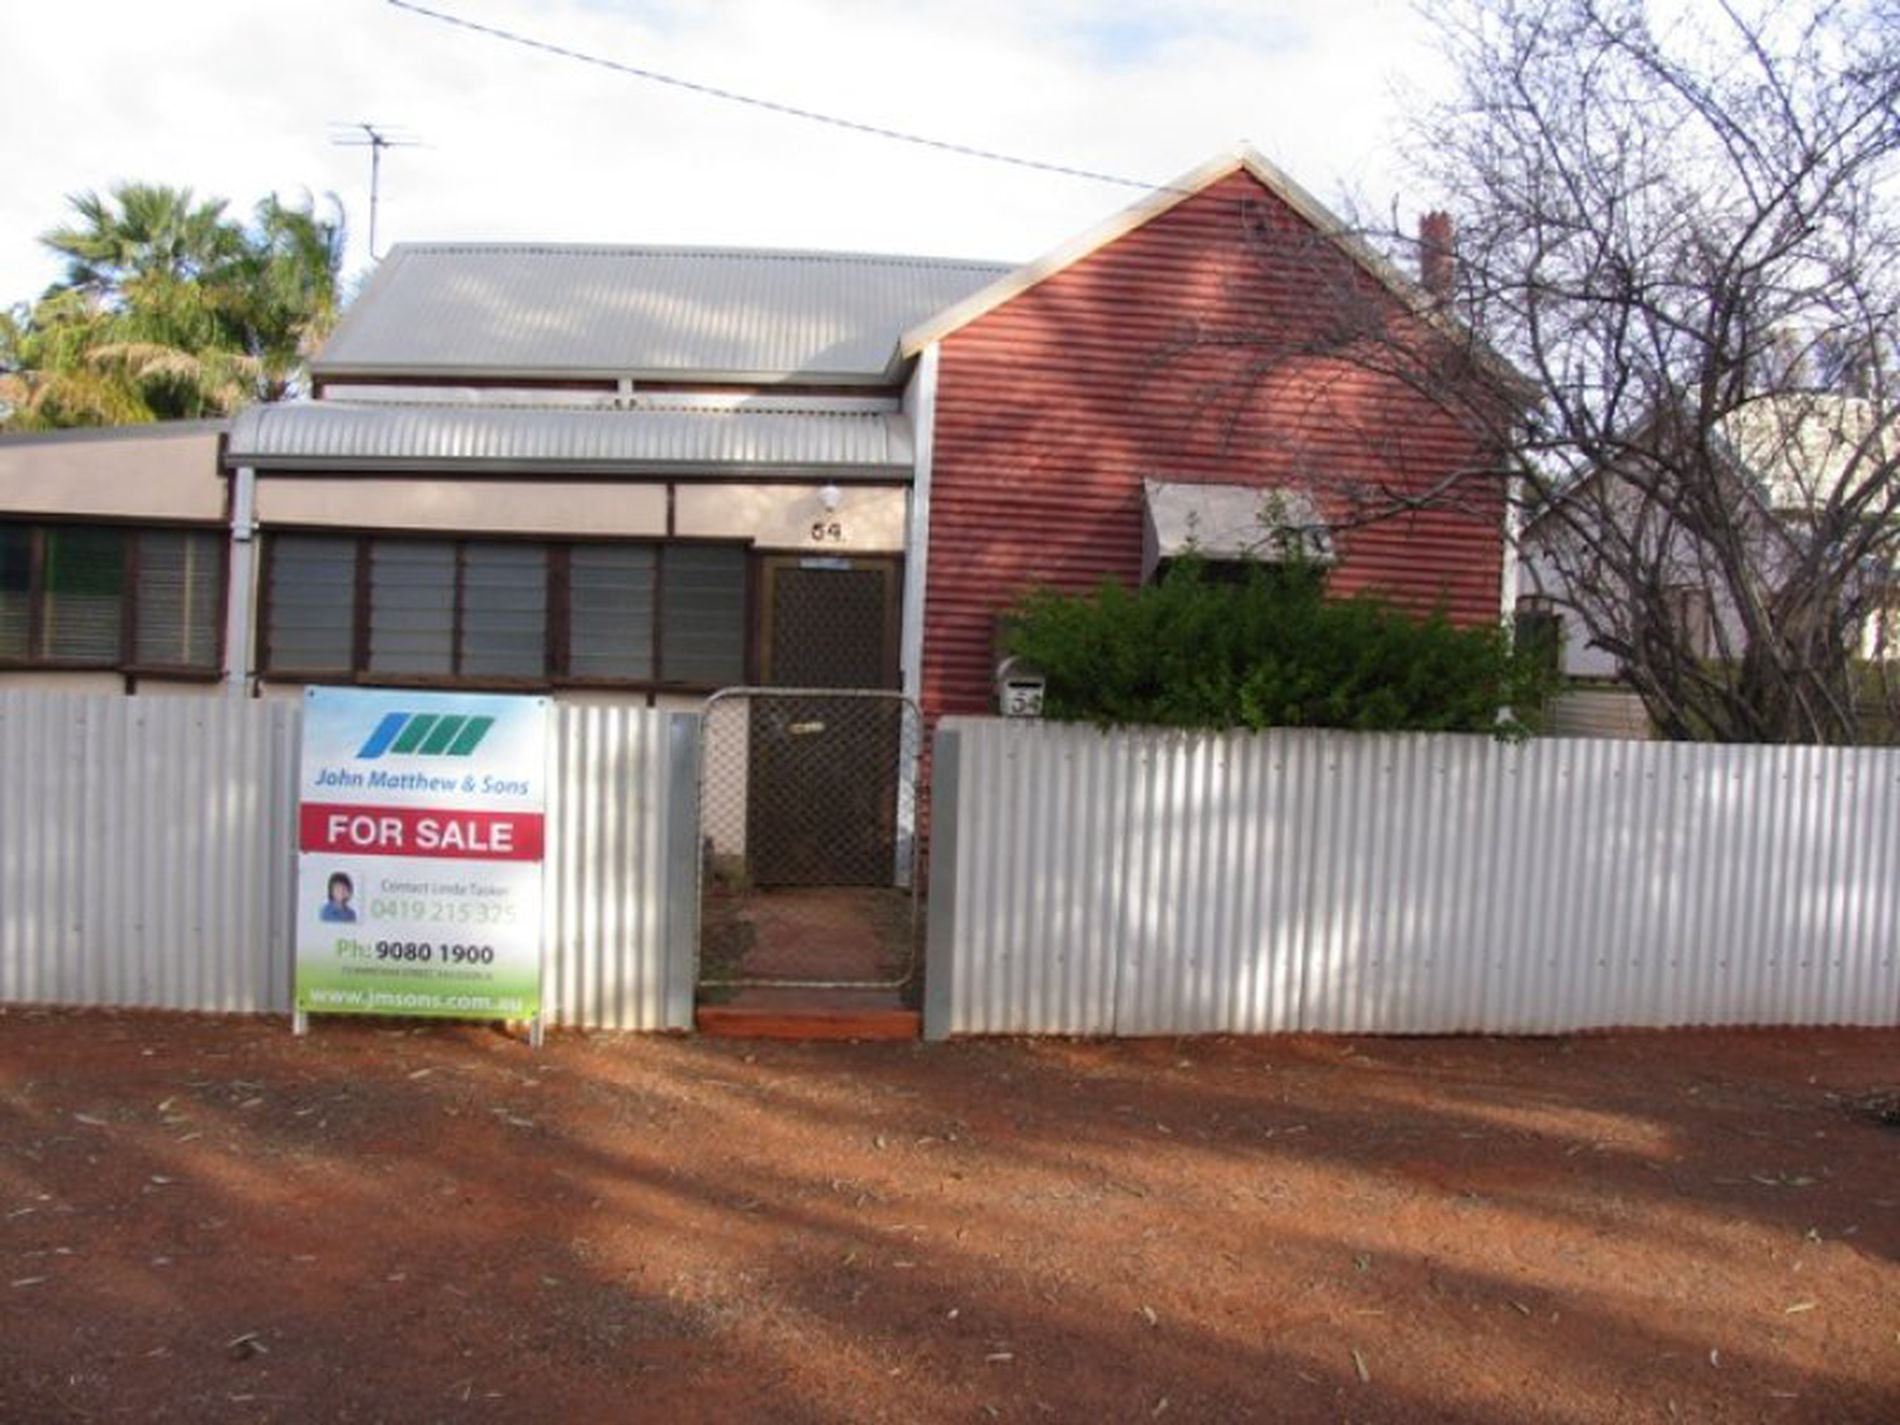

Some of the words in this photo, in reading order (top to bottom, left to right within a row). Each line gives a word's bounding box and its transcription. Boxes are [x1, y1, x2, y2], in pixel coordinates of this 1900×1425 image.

[315, 767, 363, 786] John
[367, 770, 457, 792] Matthew
[460, 776, 476, 792] &
[481, 776, 530, 796] Sons
[327, 815, 403, 846] FOR
[415, 819, 514, 851] SALE
[381, 879, 429, 895] Contact
[370, 899, 426, 921] 0419
[430, 902, 471, 923] 215
[335, 938, 371, 959] Ph:
[375, 941, 433, 962] 9080
[439, 944, 494, 964] 1900
[310, 987, 523, 1012] www.jmsons.com.au
